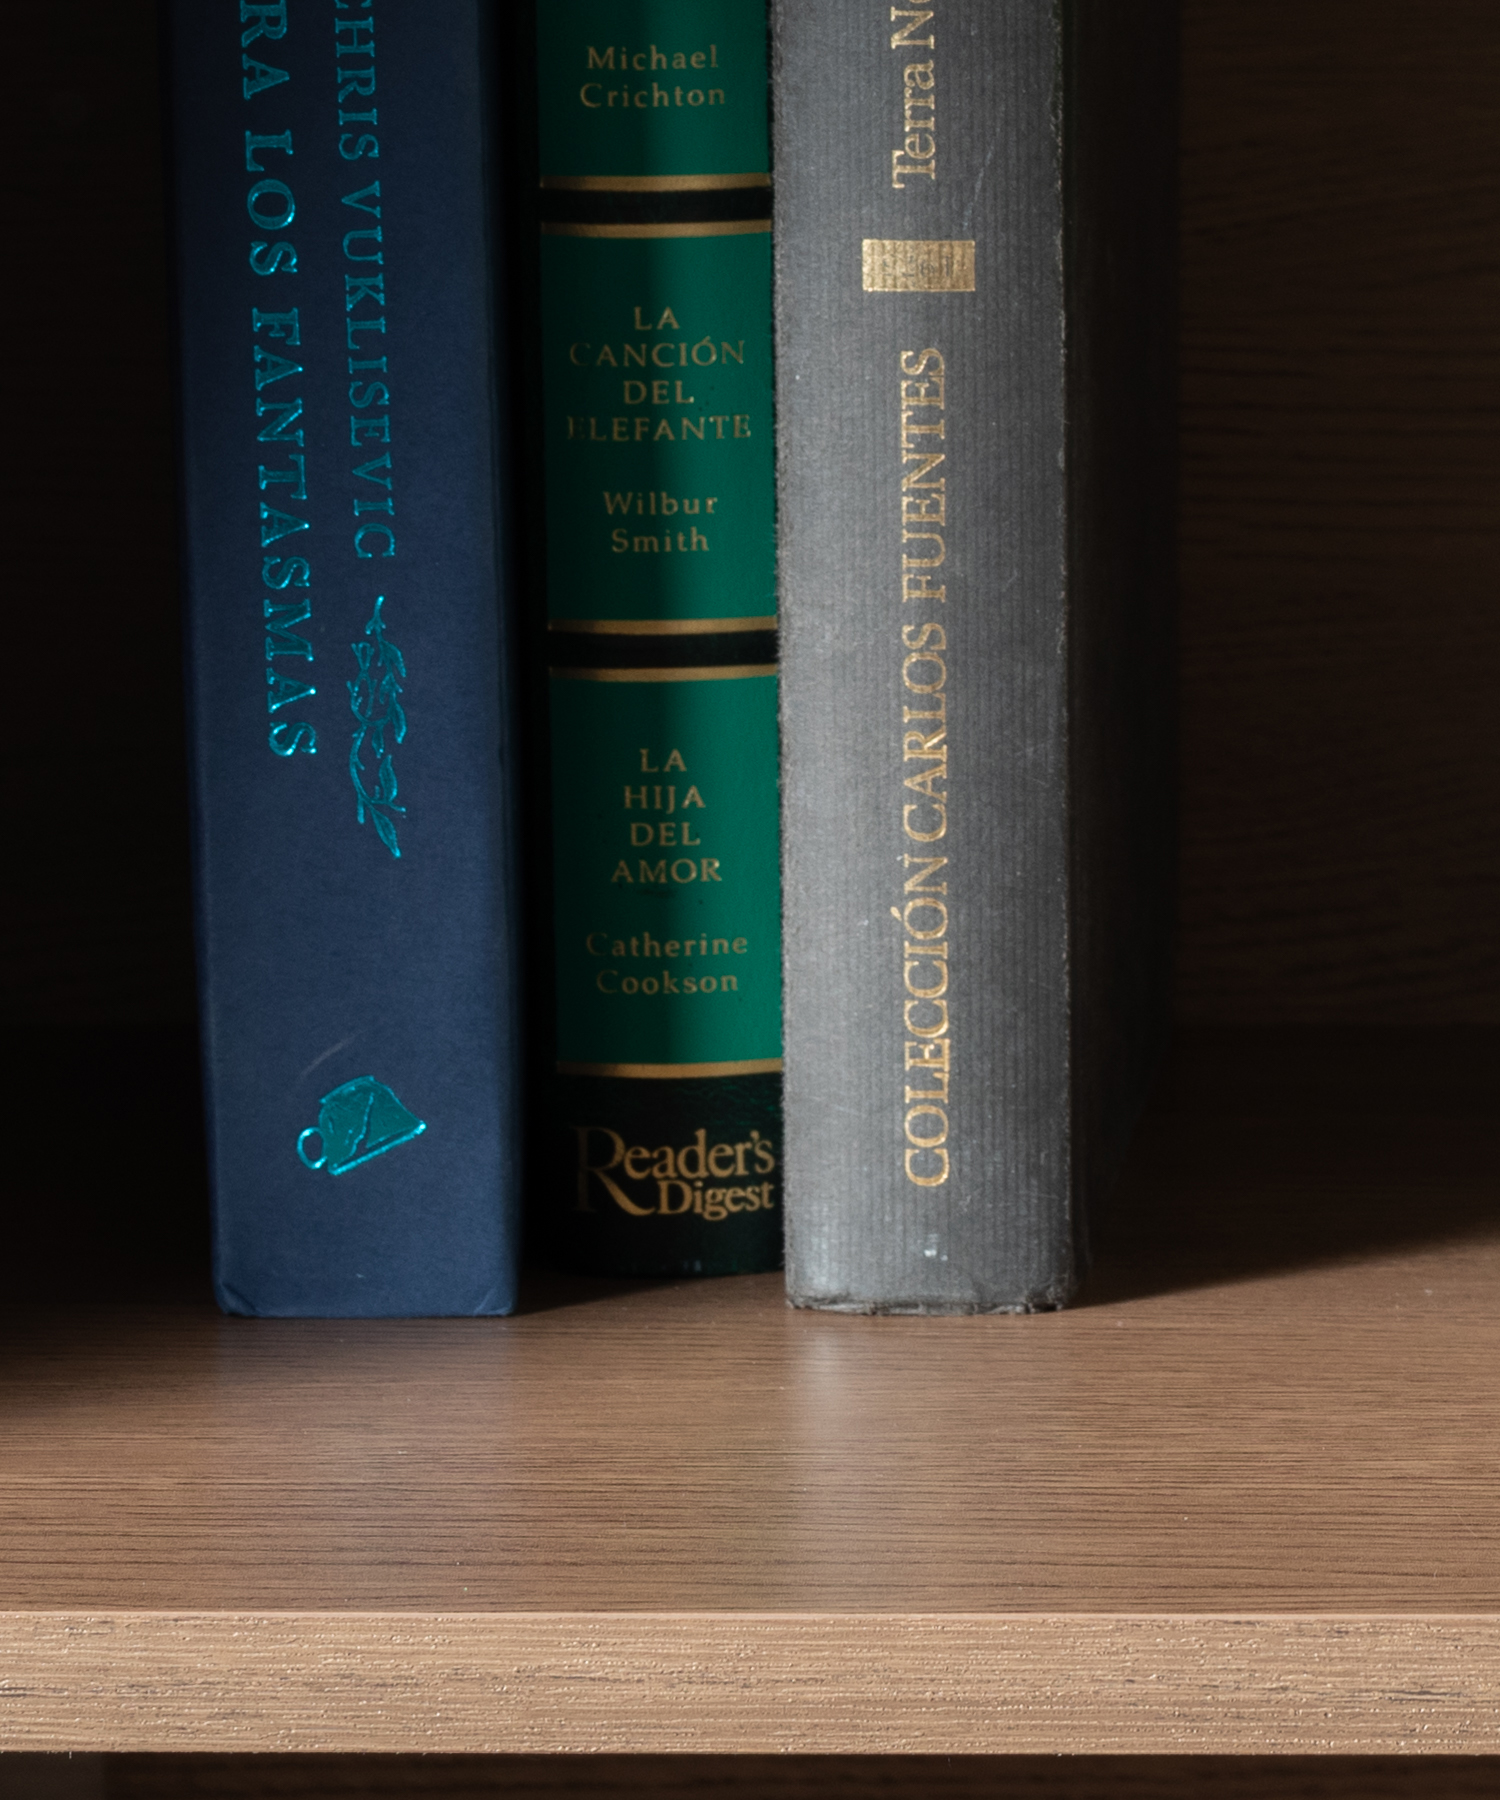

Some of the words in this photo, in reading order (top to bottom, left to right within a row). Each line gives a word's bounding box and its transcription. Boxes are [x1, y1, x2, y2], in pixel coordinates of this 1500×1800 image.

[585, 43, 720, 71] Michael
[578, 81, 727, 110] Crichton
[891, 59, 937, 190] Terra
[243, 128, 299, 278] LOS
[632, 305, 681, 332] LA
[568, 335, 746, 369] CANCIÓN
[340, 179, 396, 560] VUKLISEVIC
[622, 379, 695, 406] DEL
[565, 413, 752, 442] ELEFANTE
[901, 344, 947, 604] FUENTES
[601, 490, 719, 517] Wilbur
[250, 306, 318, 758] FANTASMAS
[610, 525, 710, 554] Smith
[901, 620, 949, 844] CARLOS
[638, 747, 688, 774] LA
[622, 784, 707, 812] HIJA
[628, 821, 702, 848] DEL
[610, 856, 723, 885] AMOR
[585, 930, 749, 959] Catherine
[595, 968, 740, 996] Cookson
[889, 852, 951, 1189] COLECCIÓN
[568, 1123, 776, 1217] Reader's
[656, 1178, 776, 1222] Digest
